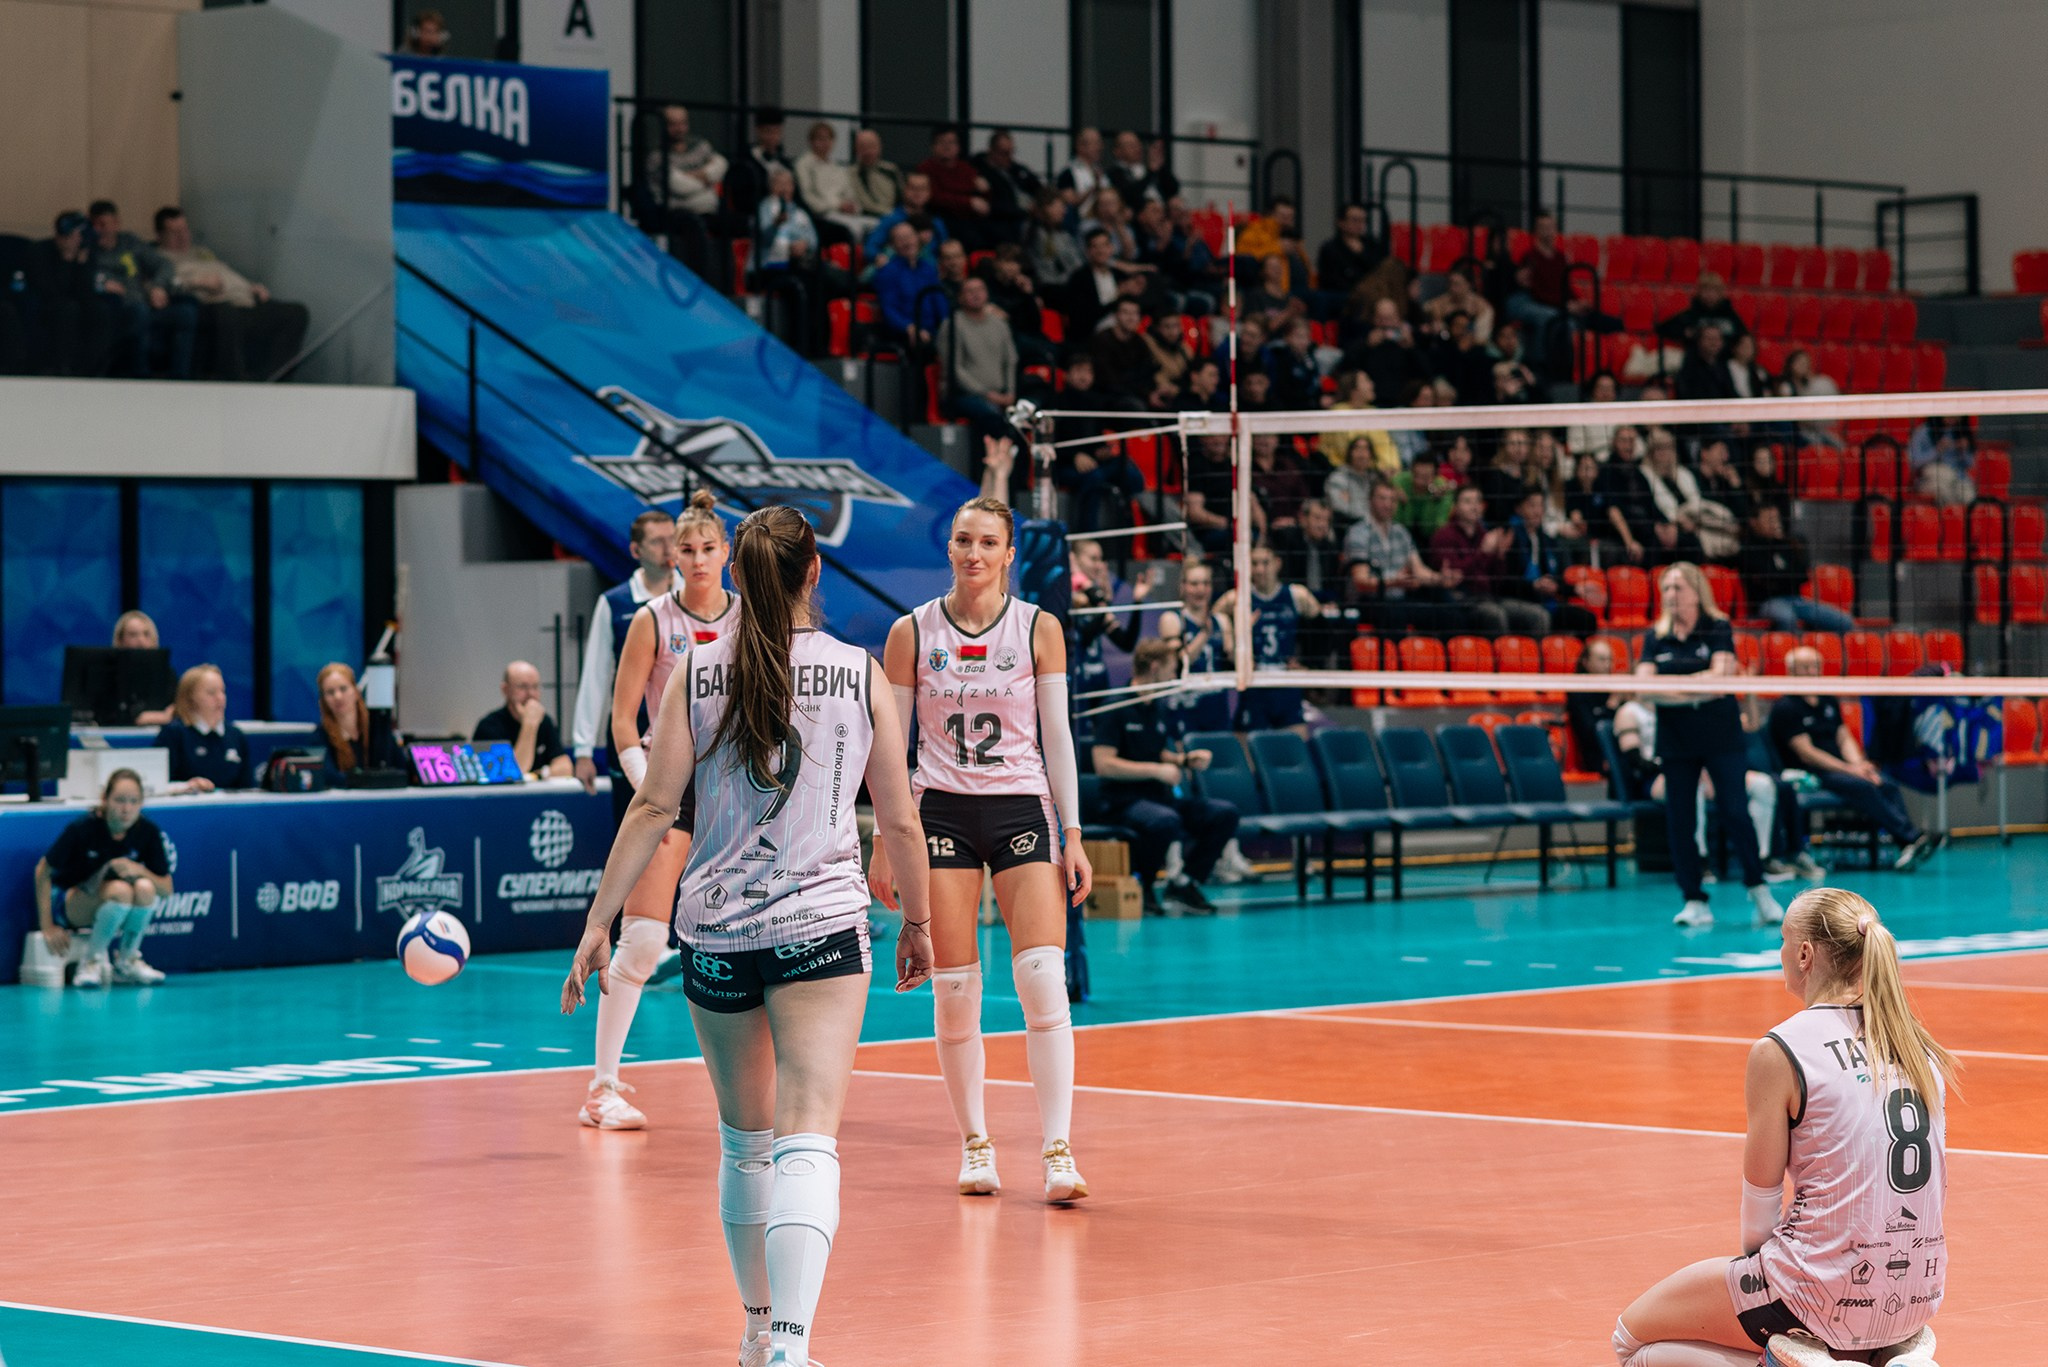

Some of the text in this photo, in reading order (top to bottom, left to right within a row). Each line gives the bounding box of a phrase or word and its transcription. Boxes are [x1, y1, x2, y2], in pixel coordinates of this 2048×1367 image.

[1262, 625, 1278, 657] 3
[964, 665, 986, 673] ВФВ
[944, 713, 1005, 768] 12
[829, 741, 845, 829] БЕЛЮВЕЛИРТОРГ
[928, 835, 956, 857] 12
[281, 880, 340, 912] ВФВ
[695, 923, 731, 933] FENOX
[1882, 1087, 1932, 1195] 8
[1923, 1257, 1938, 1278] H
[1836, 1298, 1876, 1308] FENOX
